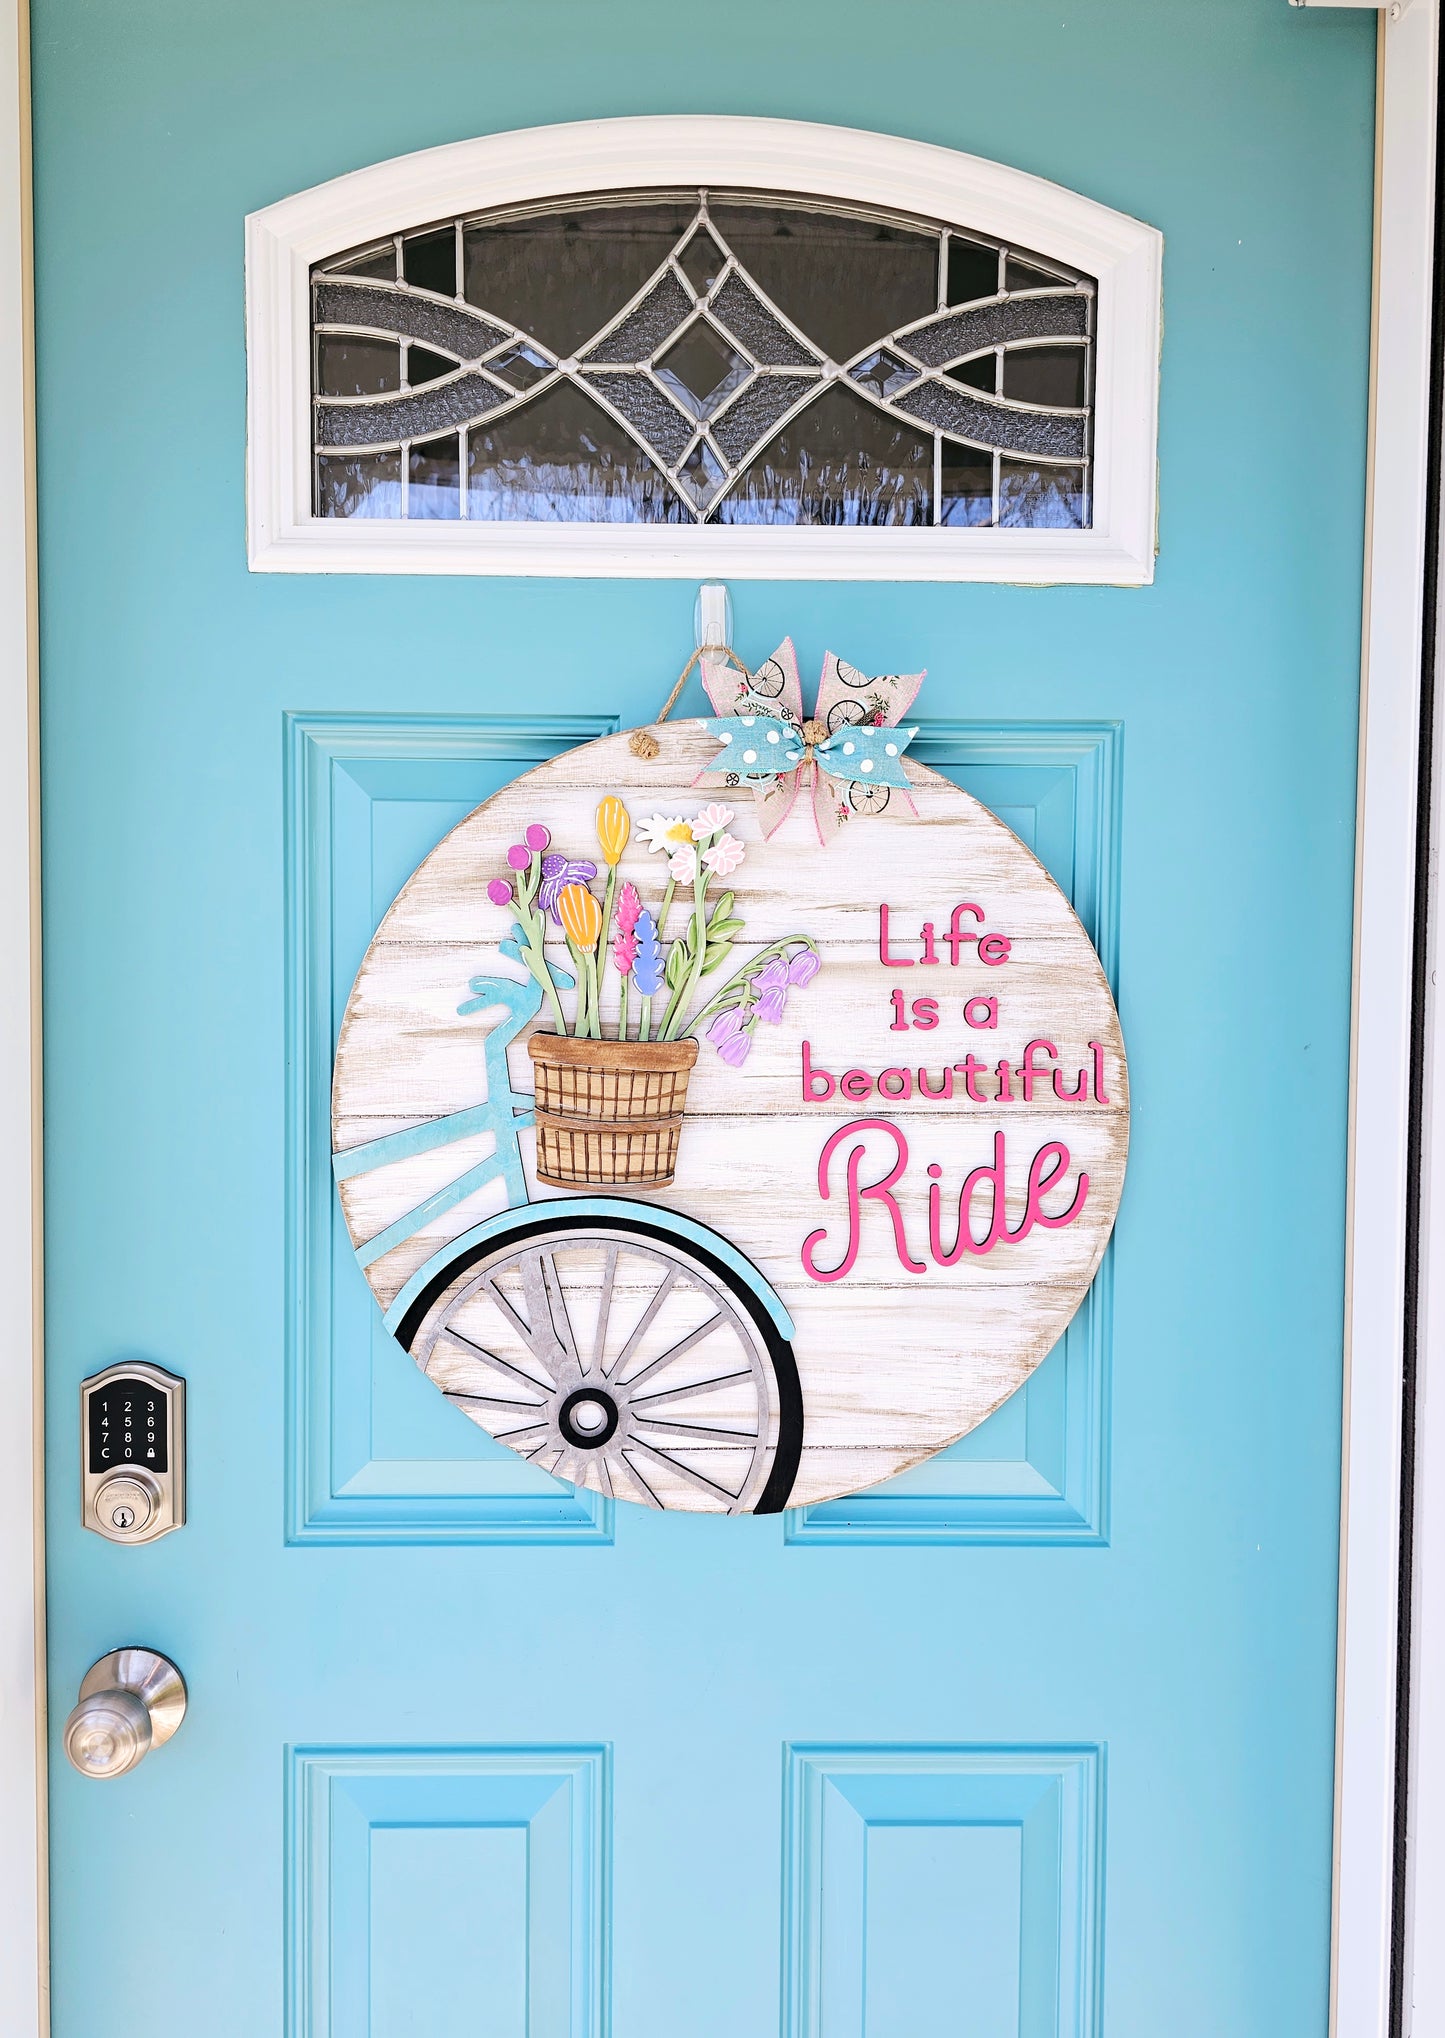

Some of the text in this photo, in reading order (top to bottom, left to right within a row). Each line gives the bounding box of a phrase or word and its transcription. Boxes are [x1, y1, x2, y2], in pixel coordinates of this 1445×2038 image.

[879, 903, 1012, 967] Life
[889, 989, 999, 1031] is a
[802, 1039, 1110, 1104] beautiful
[801, 1118, 1090, 1283] Ride
[102, 1401, 155, 1412] 1 2 3
[101, 1416, 155, 1427] 4 5 6
[101, 1432, 155, 1443] 7 8 9
[101, 1447, 132, 1458] C 0
